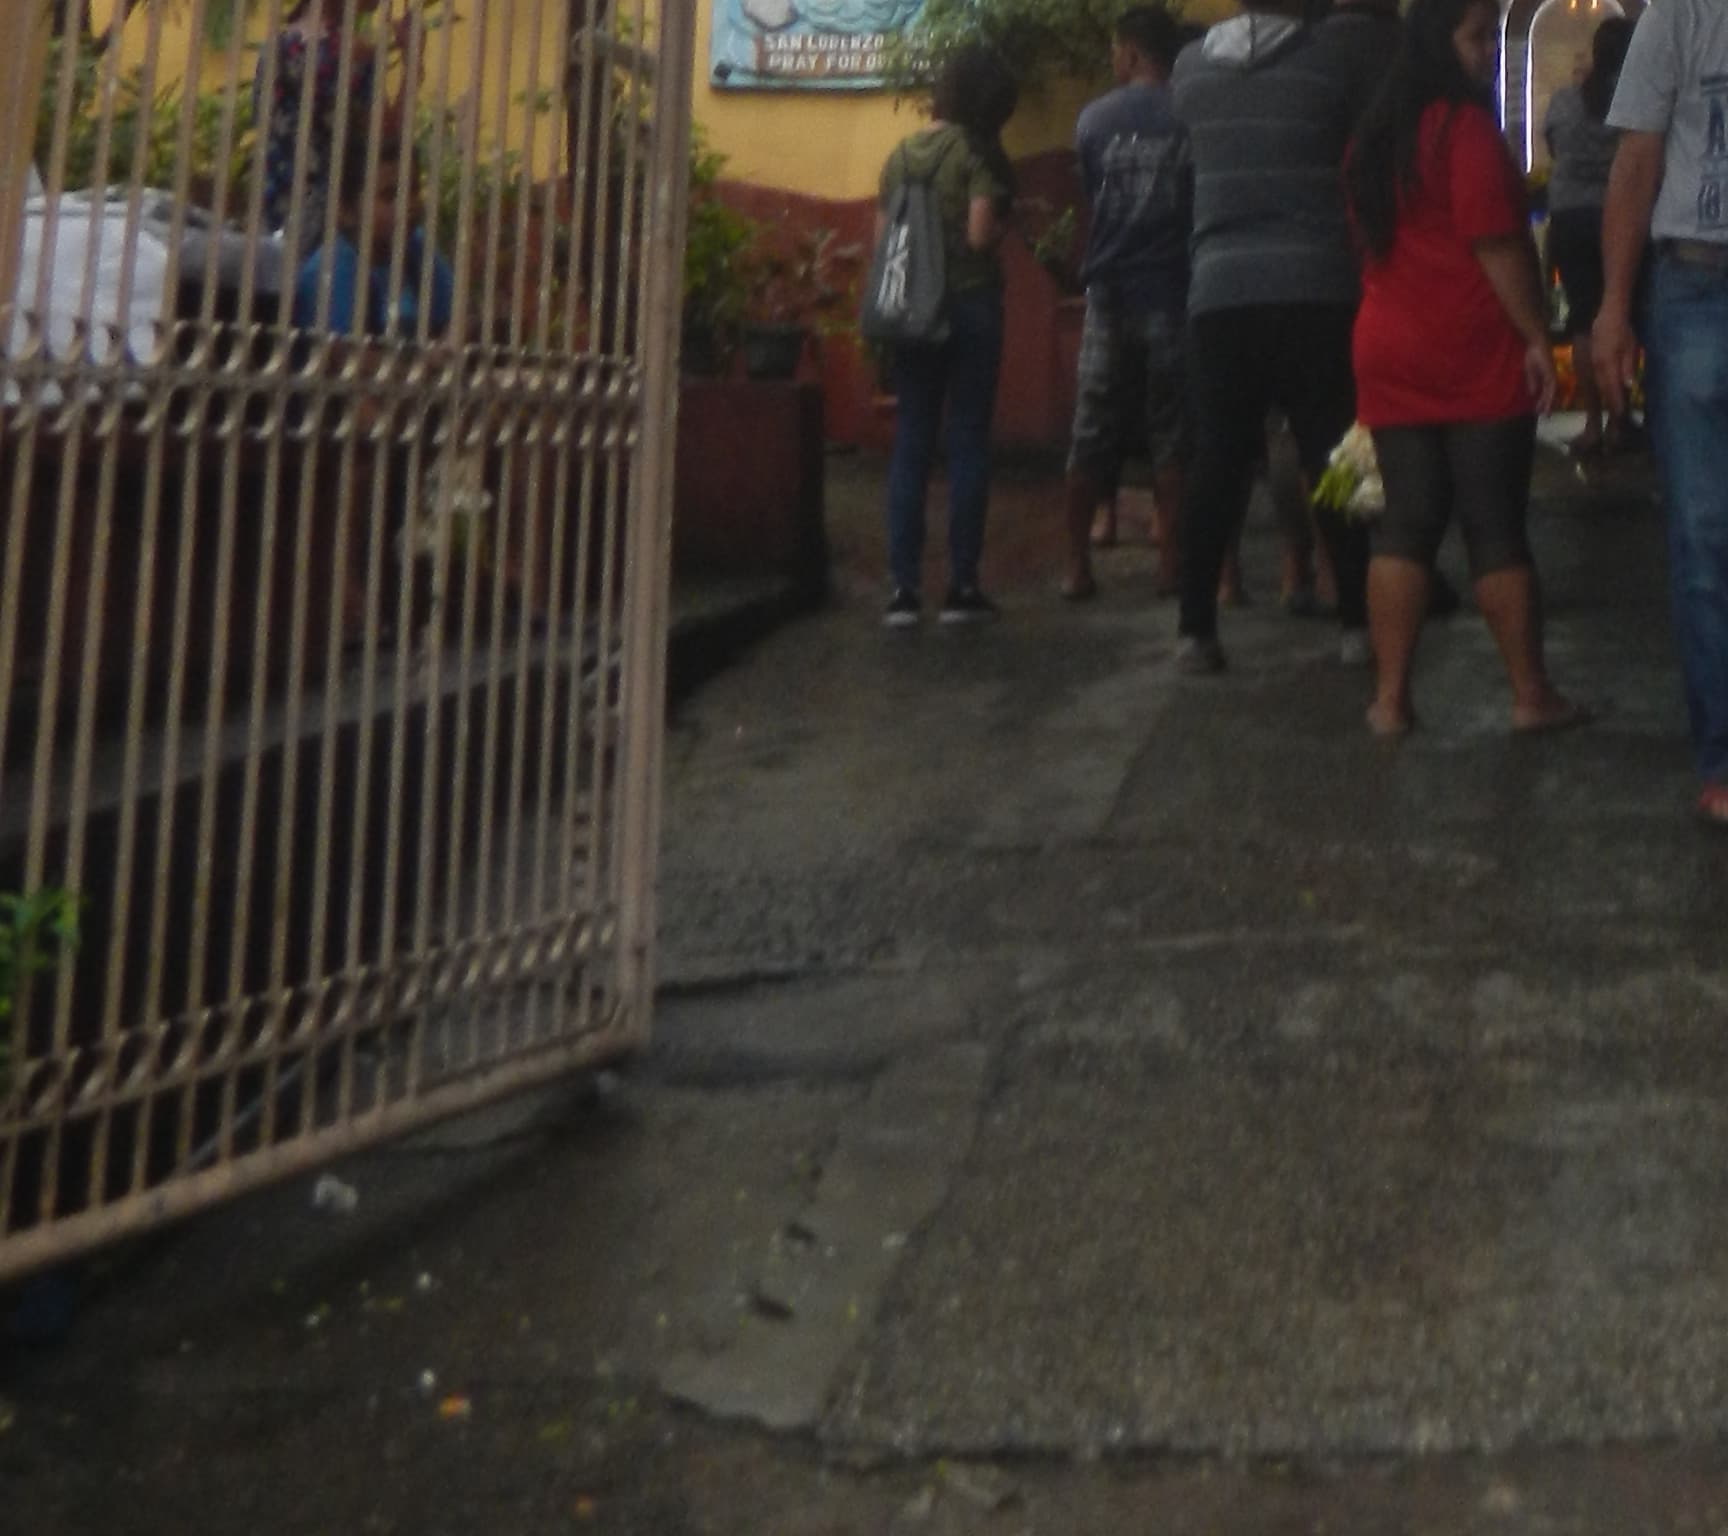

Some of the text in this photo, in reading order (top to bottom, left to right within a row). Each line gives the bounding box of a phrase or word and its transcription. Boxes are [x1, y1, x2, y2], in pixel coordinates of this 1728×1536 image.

[763, 32, 803, 51] SAN
[806, 32, 886, 51] LORENZO
[768, 53, 820, 73] PRAY
